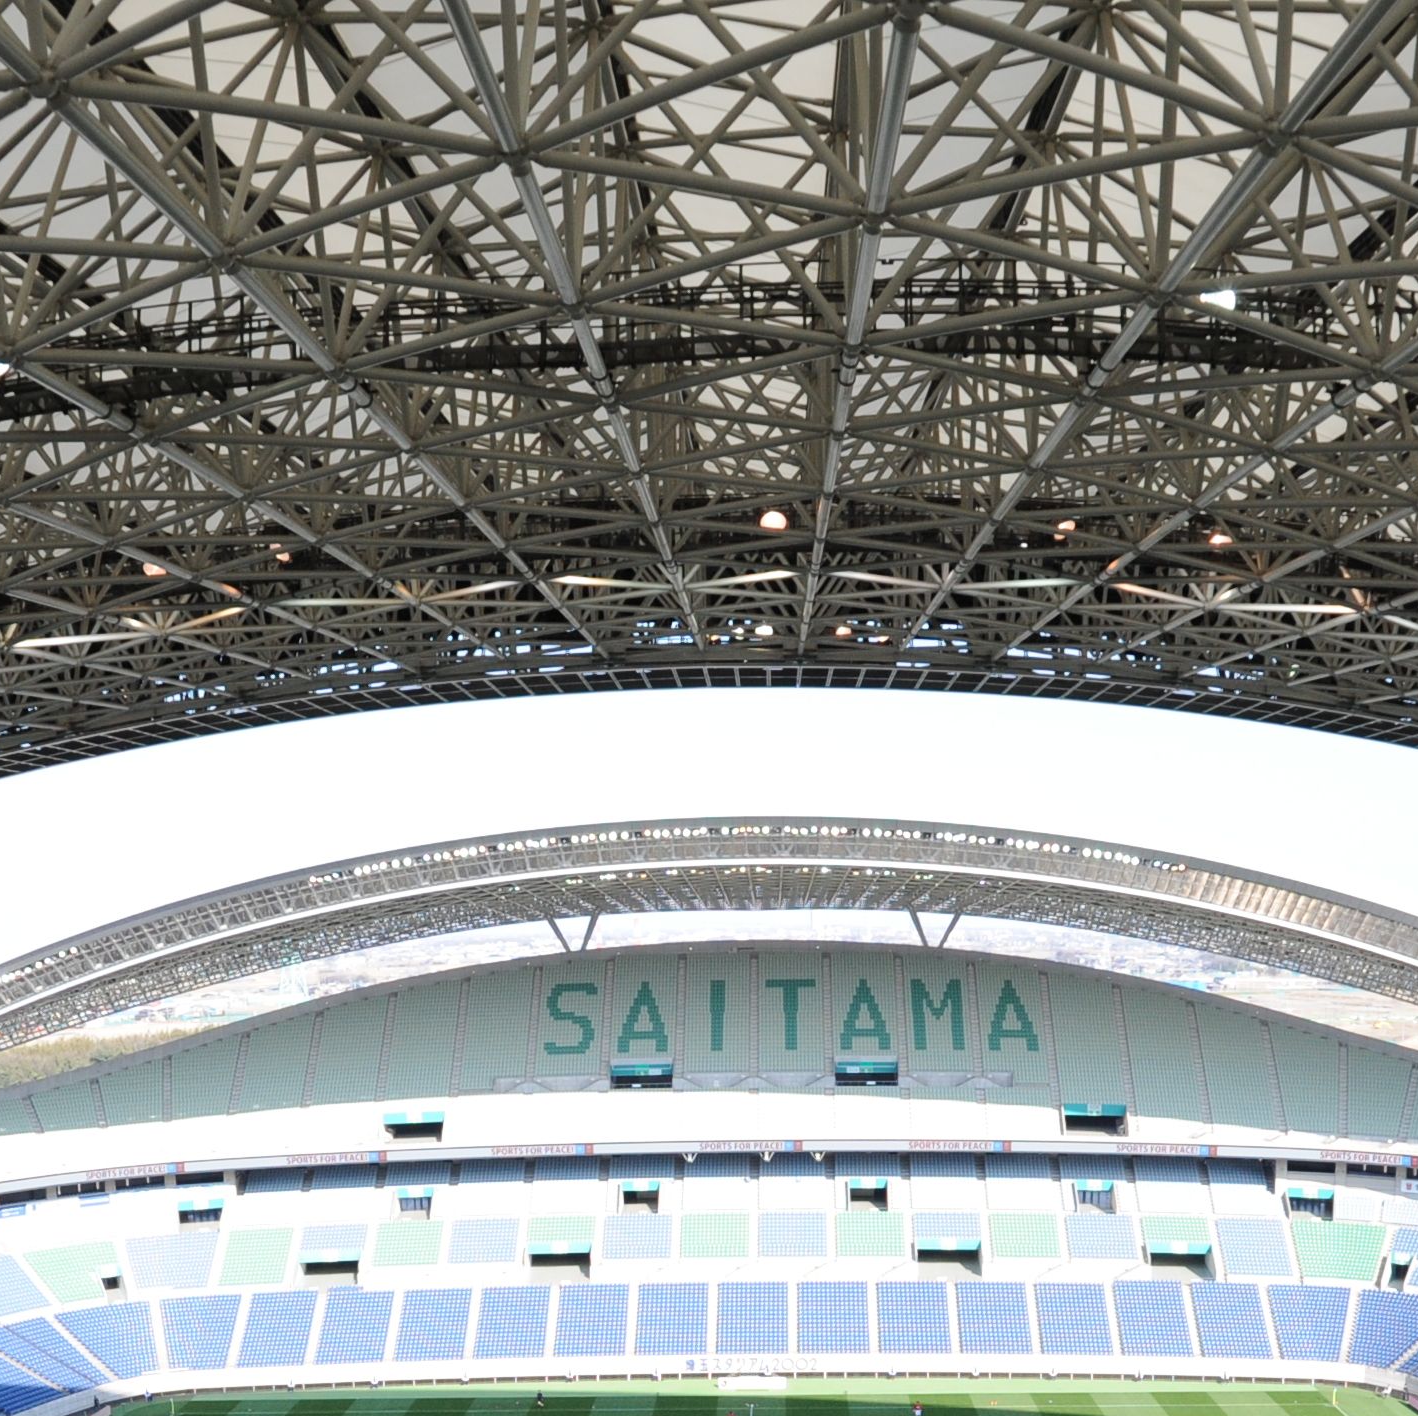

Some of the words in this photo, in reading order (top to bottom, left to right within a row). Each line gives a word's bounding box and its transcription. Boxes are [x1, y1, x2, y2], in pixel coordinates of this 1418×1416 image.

[543, 978, 1040, 1055] SAITAMA
[491, 1145, 525, 1156] SPORTS
[526, 1145, 544, 1155] FOR
[699, 1141, 732, 1151] SPORTS
[734, 1141, 751, 1151] FOR
[908, 1141, 942, 1151] SPORTS
[942, 1141, 960, 1151] FOR
[1116, 1143, 1149, 1153] SPORTS
[286, 1155, 318, 1165] SPORTS
[319, 1155, 337, 1163] FOR
[1320, 1151, 1353, 1161] SPORTS
[1353, 1153, 1370, 1162] FOR
[86, 1168, 119, 1180] SPORTS
[119, 1167, 136, 1178] FOR
